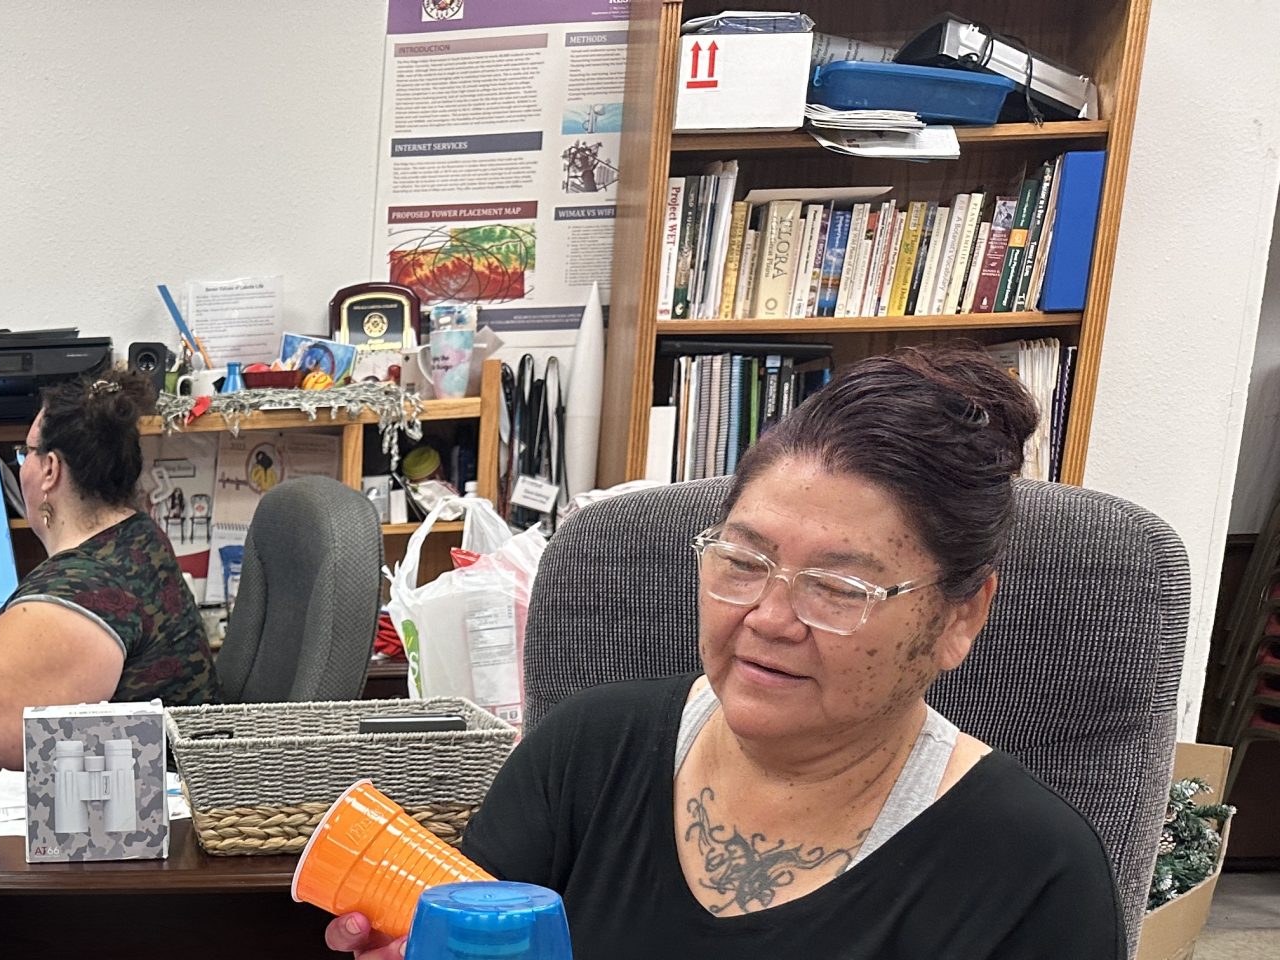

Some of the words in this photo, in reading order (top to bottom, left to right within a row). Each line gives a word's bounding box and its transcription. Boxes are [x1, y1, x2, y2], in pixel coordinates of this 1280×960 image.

[399, 44, 450, 53] INTRODUCTION
[570, 35, 607, 43] METHODS
[394, 143, 431, 152] INTERNET
[433, 141, 468, 150] SERVICES
[391, 211, 430, 219] PROPOSED
[431, 210, 461, 218] TOWER
[463, 208, 503, 217] PLACEMENT
[504, 207, 521, 215] MAP
[558, 209, 584, 218] WIMAX
[586, 209, 595, 217] VS
[596, 208, 615, 216] WIFI
[668, 187, 681, 222] Project
[967, 203, 978, 227] PLANT
[667, 224, 676, 246] WET
[850, 232, 859, 245] Wild
[949, 224, 960, 254] Botanist's
[772, 217, 793, 279] FLORA
[960, 230, 973, 265] FAMILIES
[902, 267, 911, 285] South
[939, 256, 954, 292] Vocabulary
[897, 288, 907, 311] Dakota
[34, 846, 60, 856] AT66
